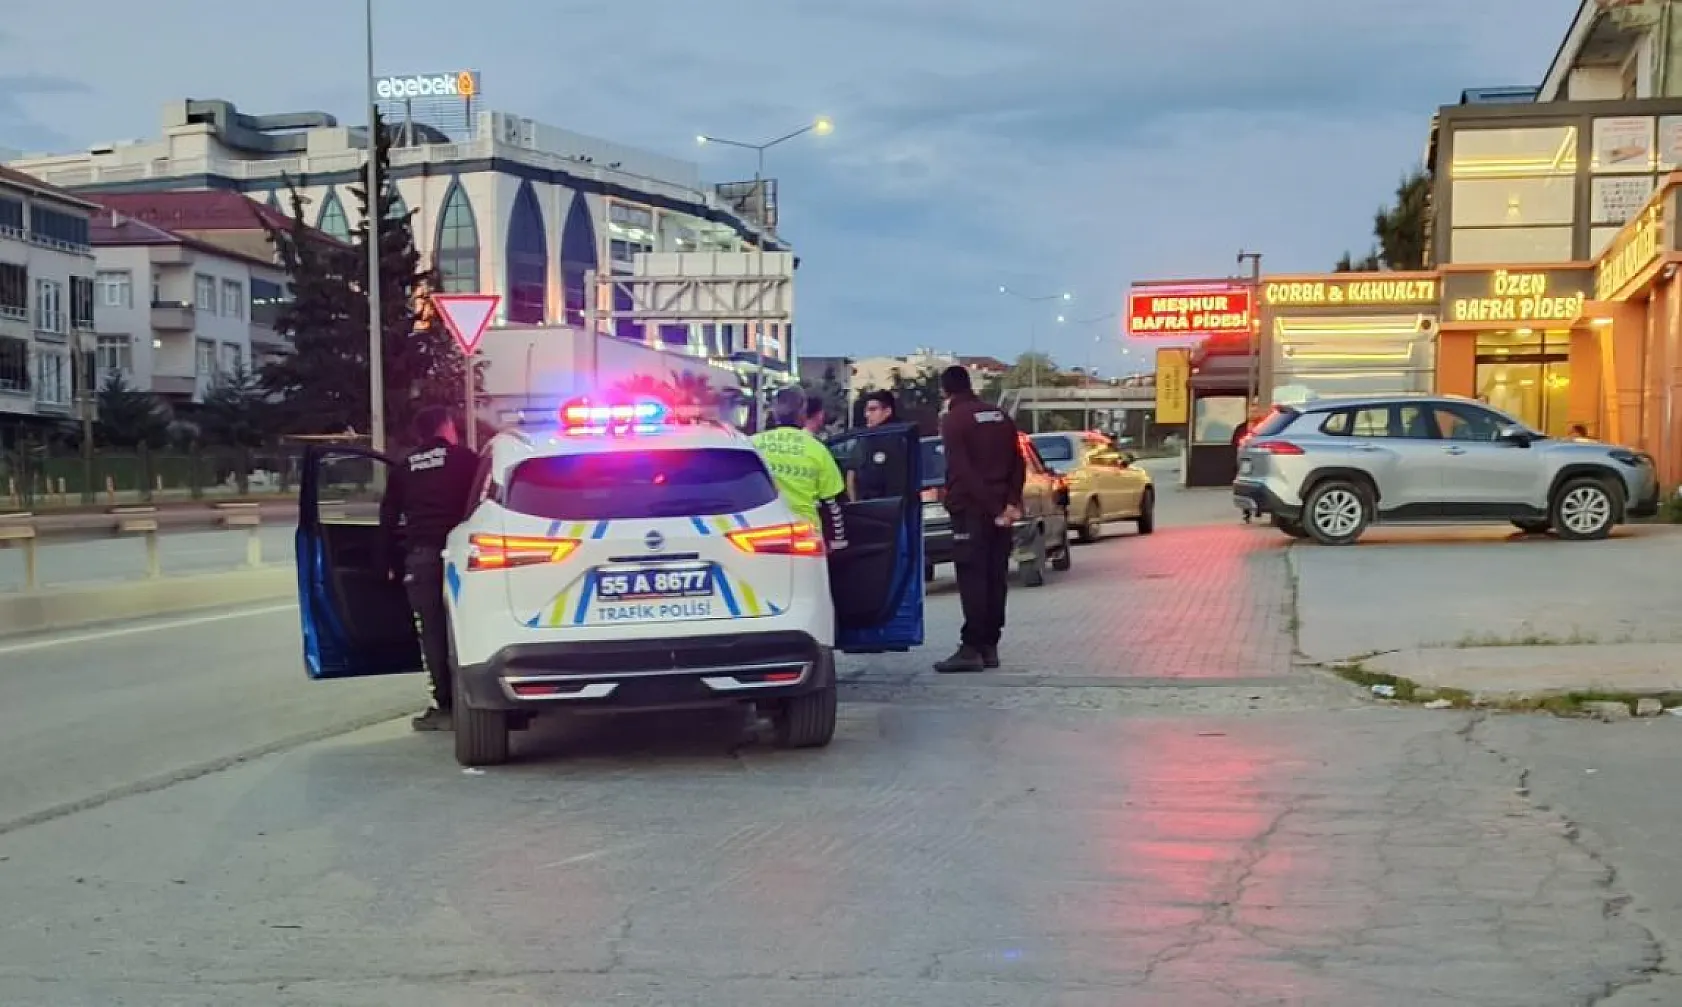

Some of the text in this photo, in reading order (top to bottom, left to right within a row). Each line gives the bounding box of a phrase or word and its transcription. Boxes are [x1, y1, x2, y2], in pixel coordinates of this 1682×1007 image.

[377, 74, 458, 98] ebebek
[1329, 286, 1344, 301] &
[1493, 269, 1546, 297] ÖZEN
[1153, 297, 1228, 314] MEŞHUR
[1455, 292, 1585, 321] BAFRA PİDESİ
[1132, 310, 1247, 330] BAFRA PİDESİ
[601, 570, 707, 595] 55 A 8677
[598, 599, 712, 621] TRAFİK POLİSİ
